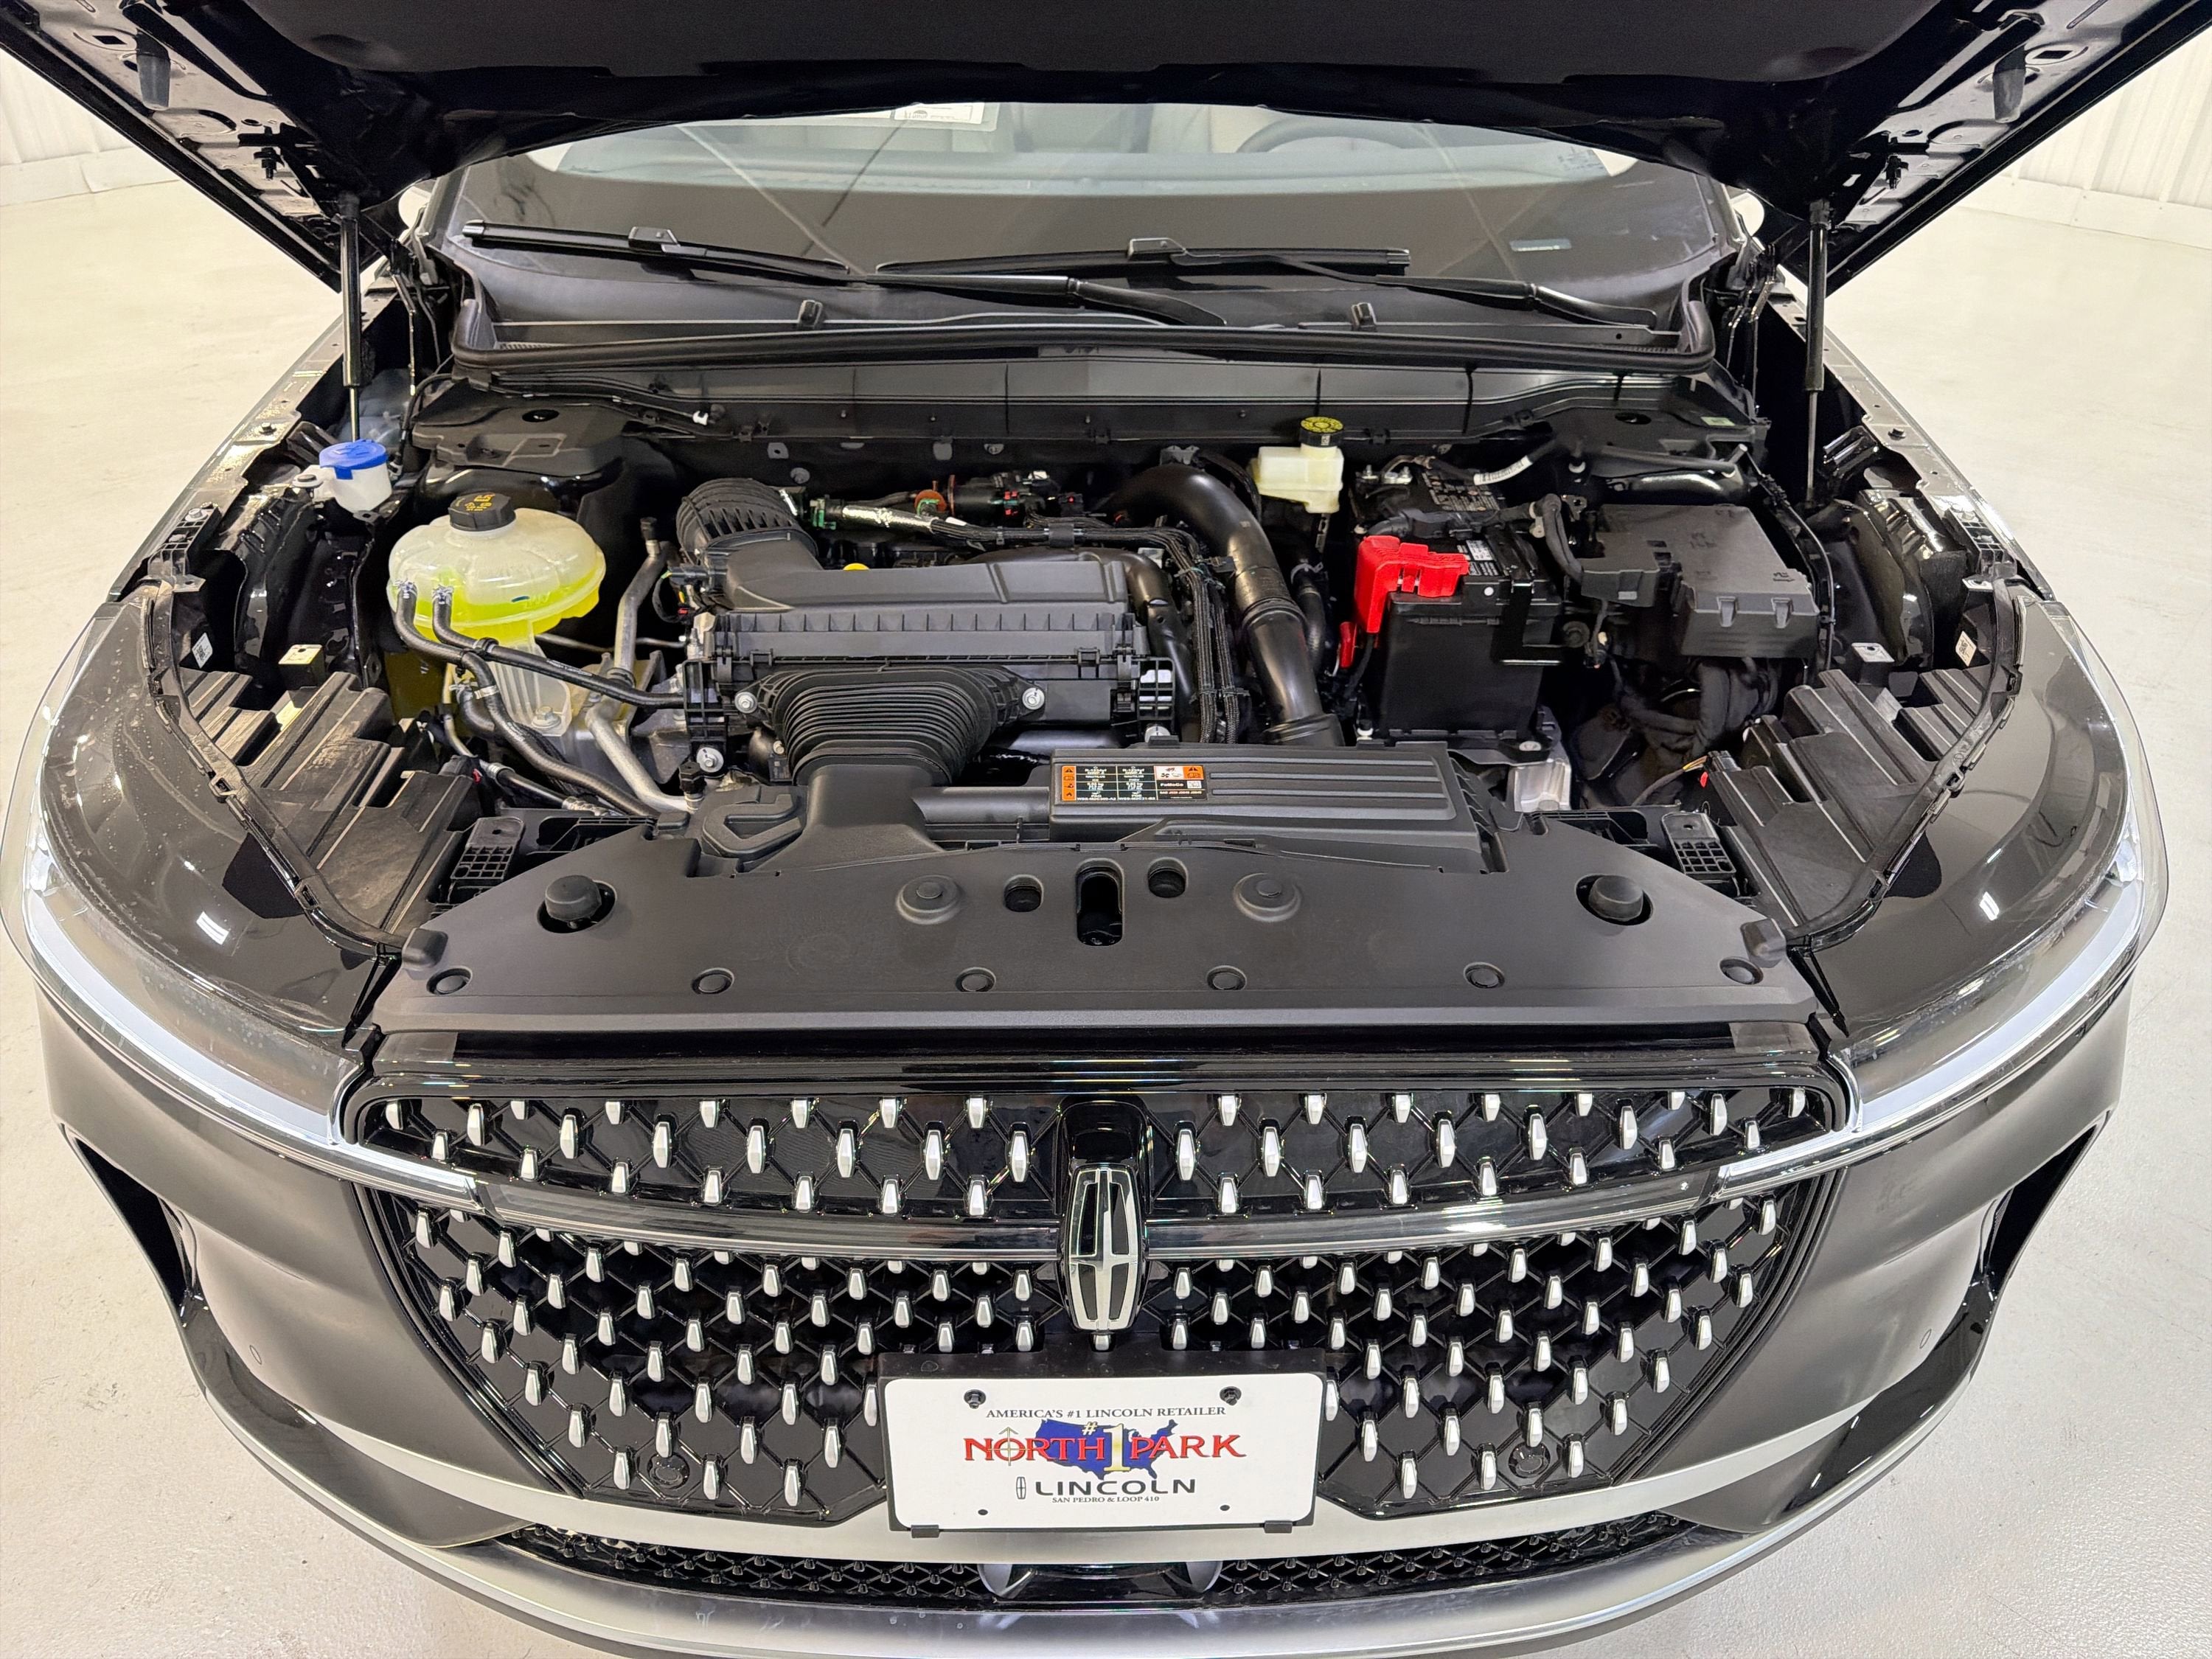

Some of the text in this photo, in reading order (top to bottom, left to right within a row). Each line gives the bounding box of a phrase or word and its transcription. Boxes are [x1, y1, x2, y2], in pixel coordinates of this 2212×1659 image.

[986, 1407, 1227, 1419] AMERICA'S #1 LINCOLN RETAILER
[964, 1434, 1248, 1462] NORTH PARK
[1035, 1479, 1196, 1496] LINCOLN
